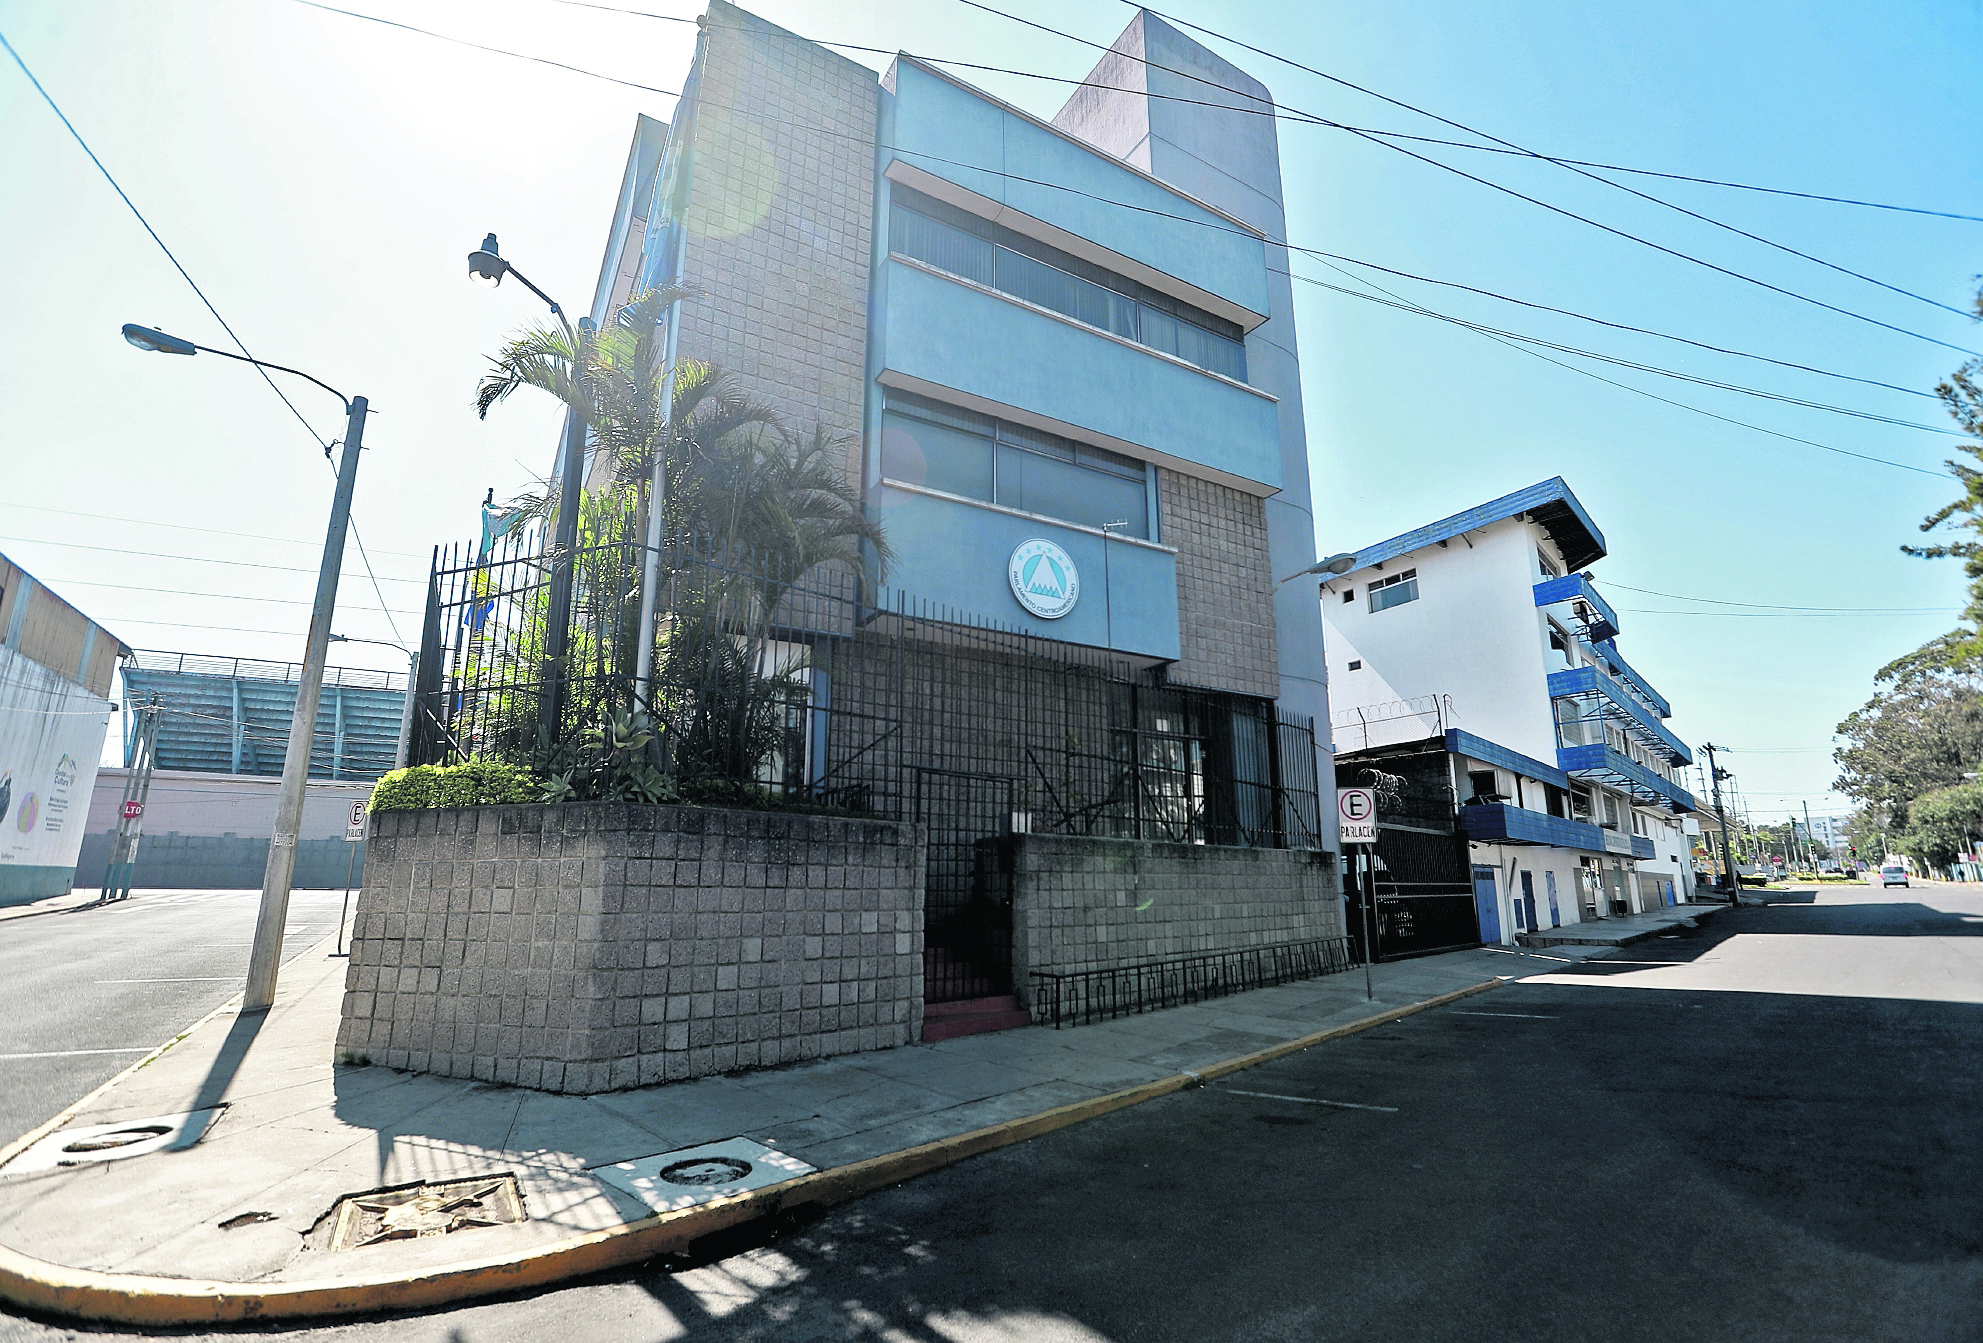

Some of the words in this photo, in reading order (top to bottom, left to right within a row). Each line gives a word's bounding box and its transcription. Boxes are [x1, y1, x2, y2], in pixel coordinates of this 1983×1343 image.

[1012, 570, 1037, 609] PARLAMENTO
[1036, 583, 1076, 614] CENTROAMERICANO
[125, 805, 141, 814] LTO
[1350, 795, 1363, 816] E
[353, 806, 361, 822] E
[1341, 826, 1376, 838] PARLACEN
